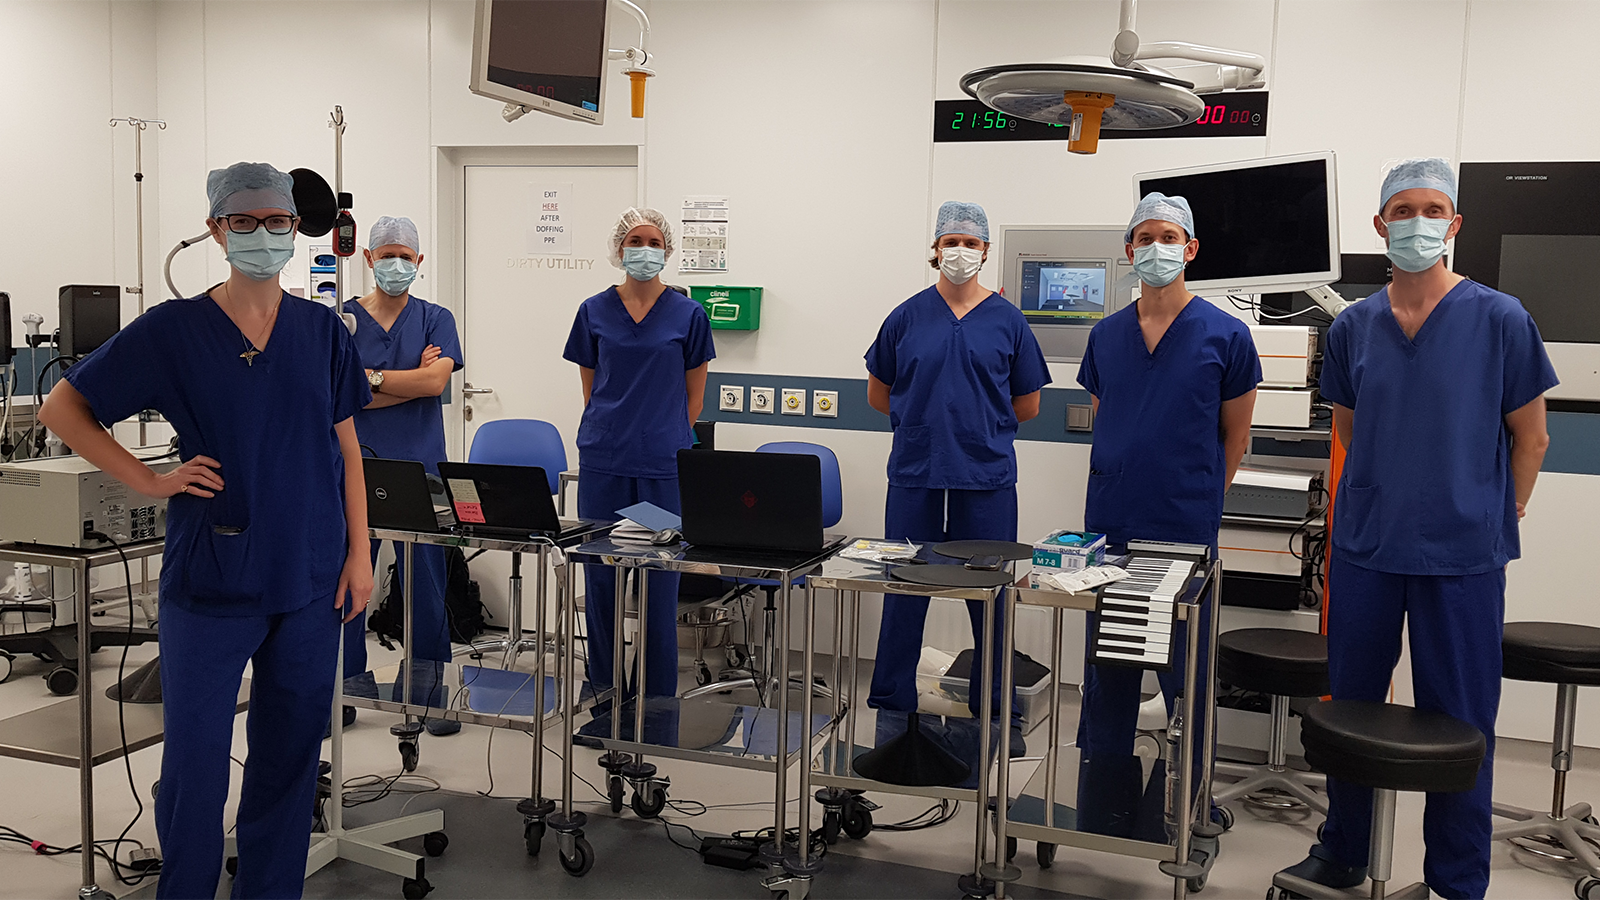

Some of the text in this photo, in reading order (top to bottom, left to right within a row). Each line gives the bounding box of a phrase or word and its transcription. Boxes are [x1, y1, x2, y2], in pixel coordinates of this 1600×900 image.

[951, 111, 1007, 129] 21:56
[542, 203, 558, 211] HERE
[536, 225, 564, 233] DOFFING
[506, 258, 594, 269] DIRTY UTILITY
